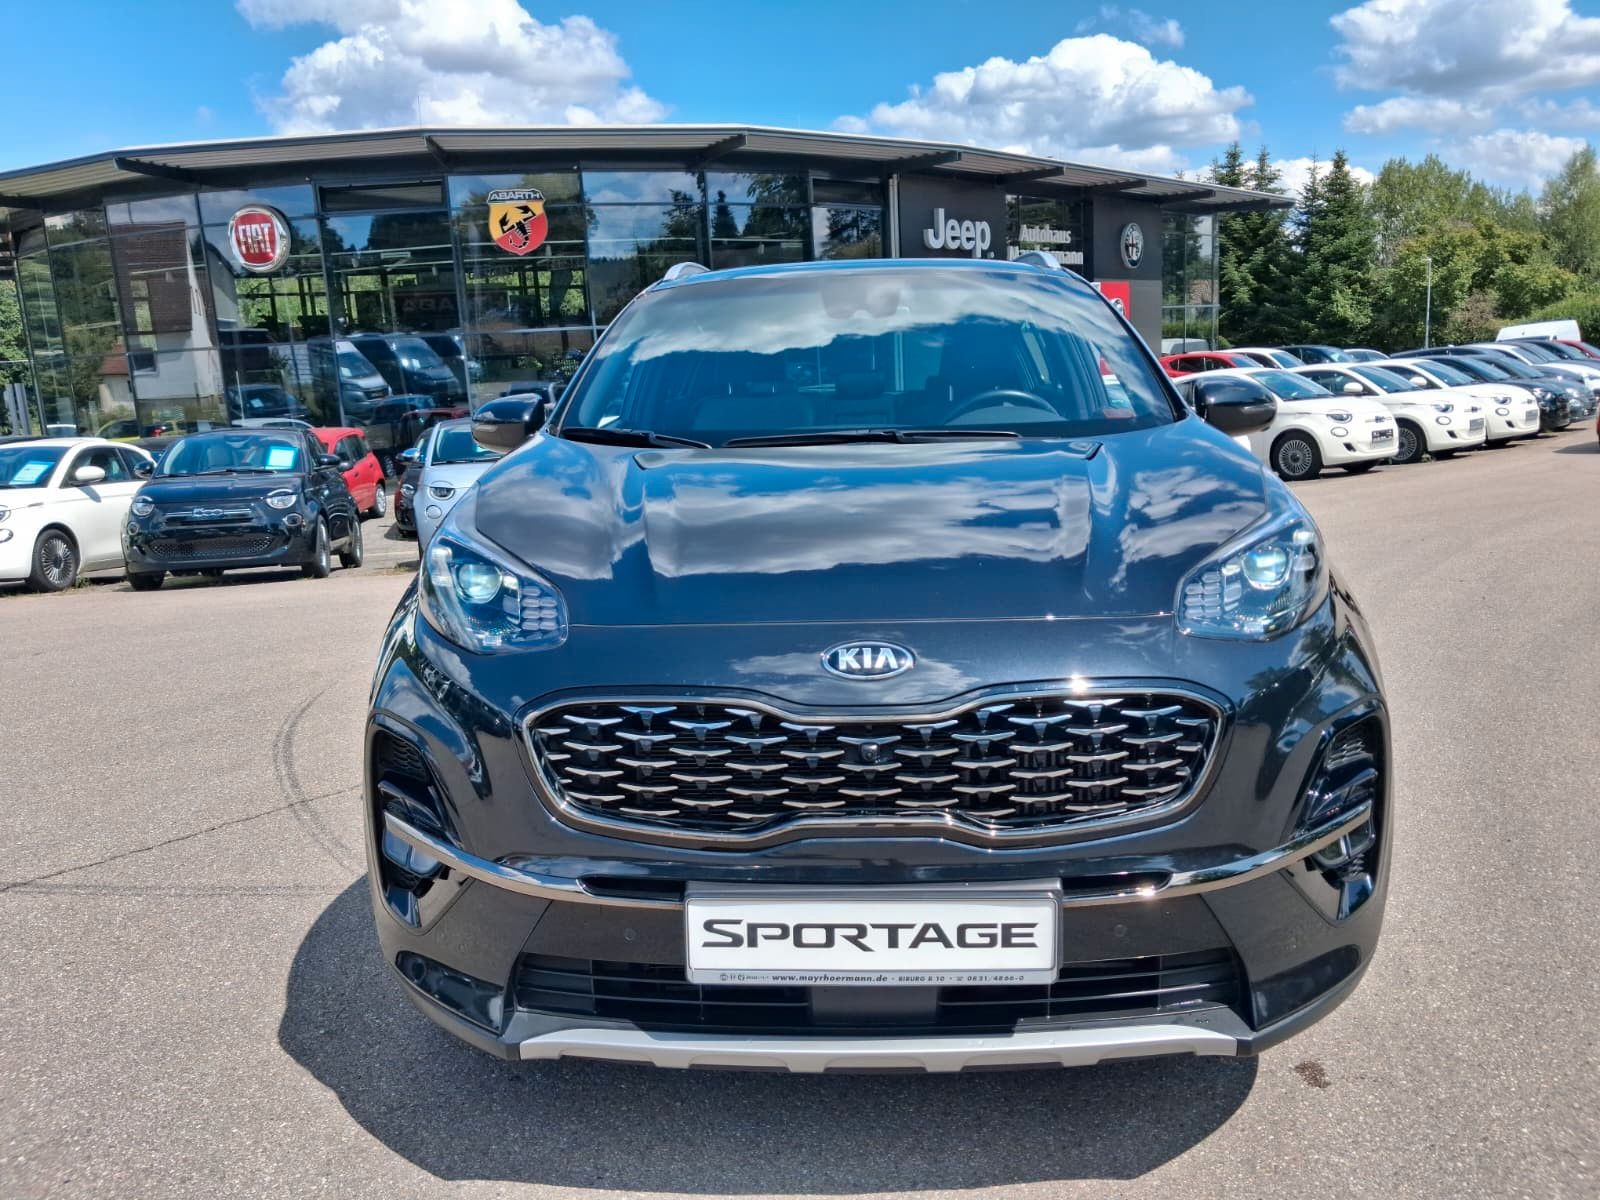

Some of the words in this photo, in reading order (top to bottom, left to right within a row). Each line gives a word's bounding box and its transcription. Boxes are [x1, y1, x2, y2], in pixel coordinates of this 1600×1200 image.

[490, 191, 540, 201] ABARTH
[238, 223, 272, 254] FIAT
[923, 207, 992, 258] Jeep
[1019, 223, 1072, 244] Autohaus
[838, 647, 898, 671] KIA
[701, 918, 1039, 953] SPORTAGE
[771, 973, 888, 983] www.mayrhoermann.de
